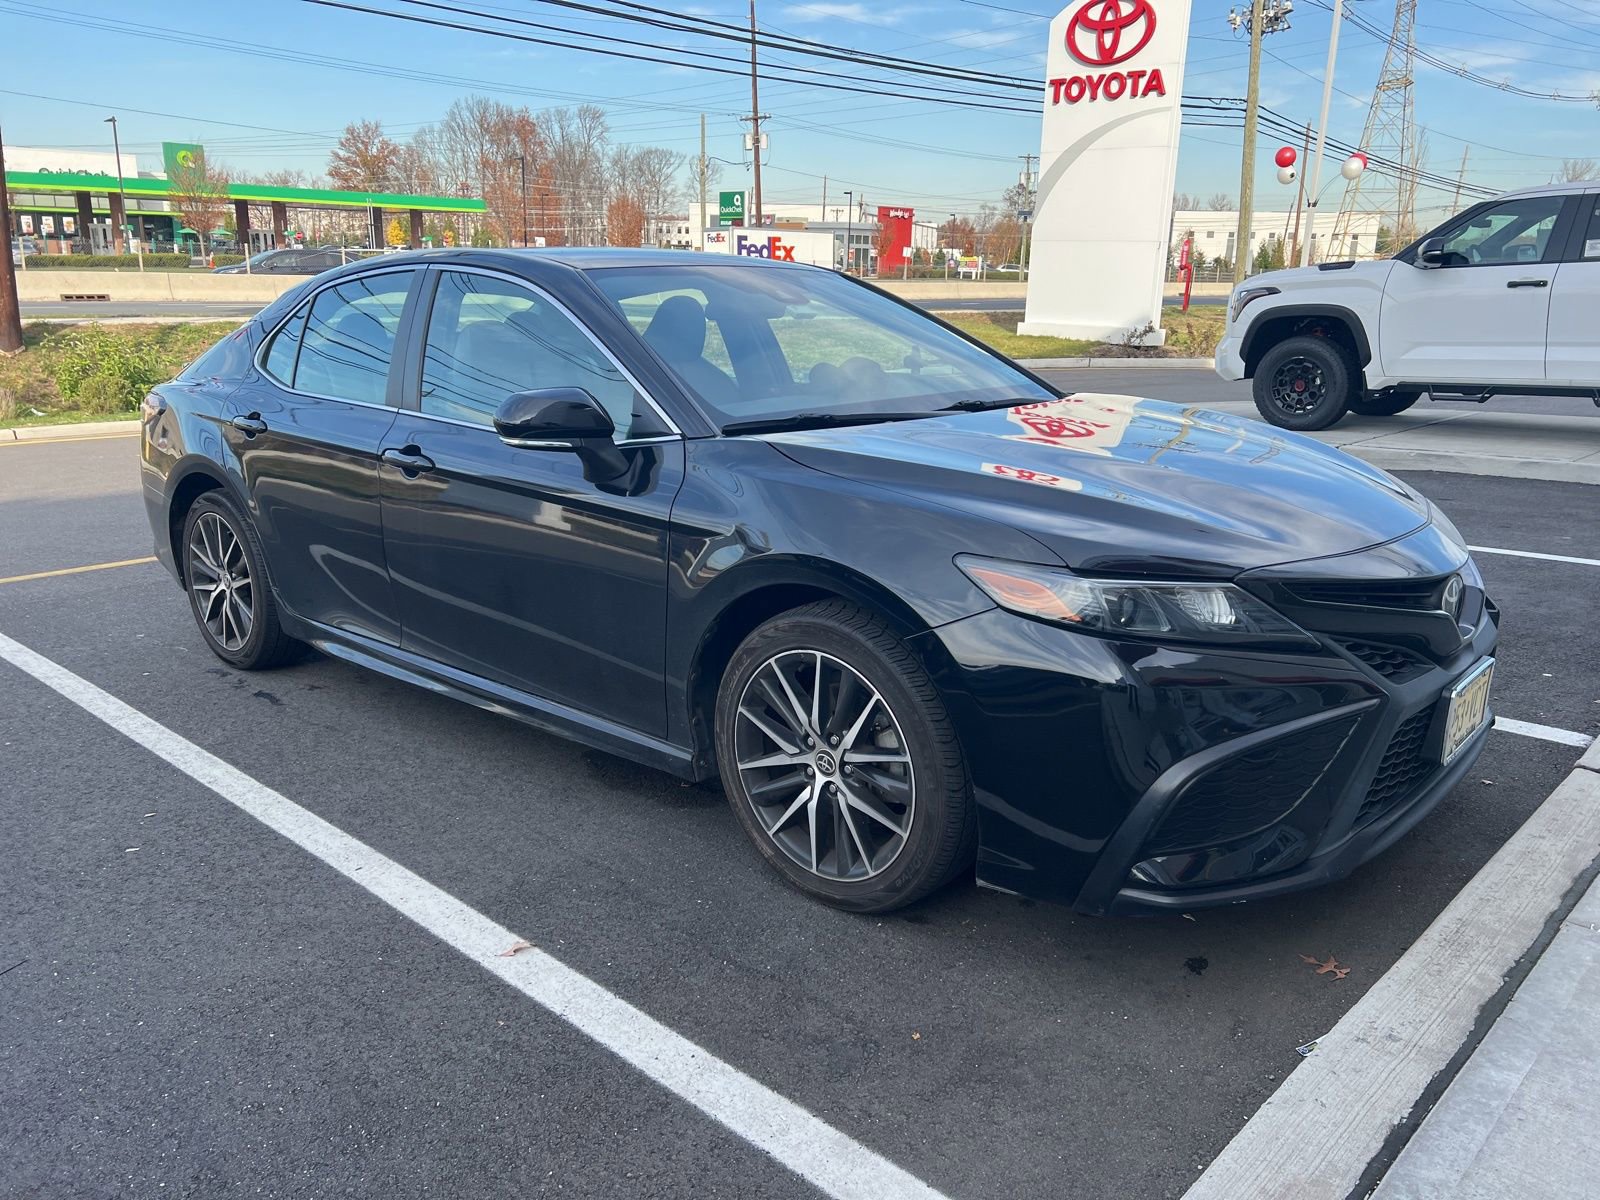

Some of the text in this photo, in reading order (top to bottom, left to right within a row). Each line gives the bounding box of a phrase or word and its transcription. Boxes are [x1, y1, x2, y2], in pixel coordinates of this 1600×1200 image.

[1049, 69, 1166, 105] TOYOTA
[720, 206, 743, 214] QuickChek
[707, 233, 726, 243] FedEx
[737, 235, 795, 262] FedEx
